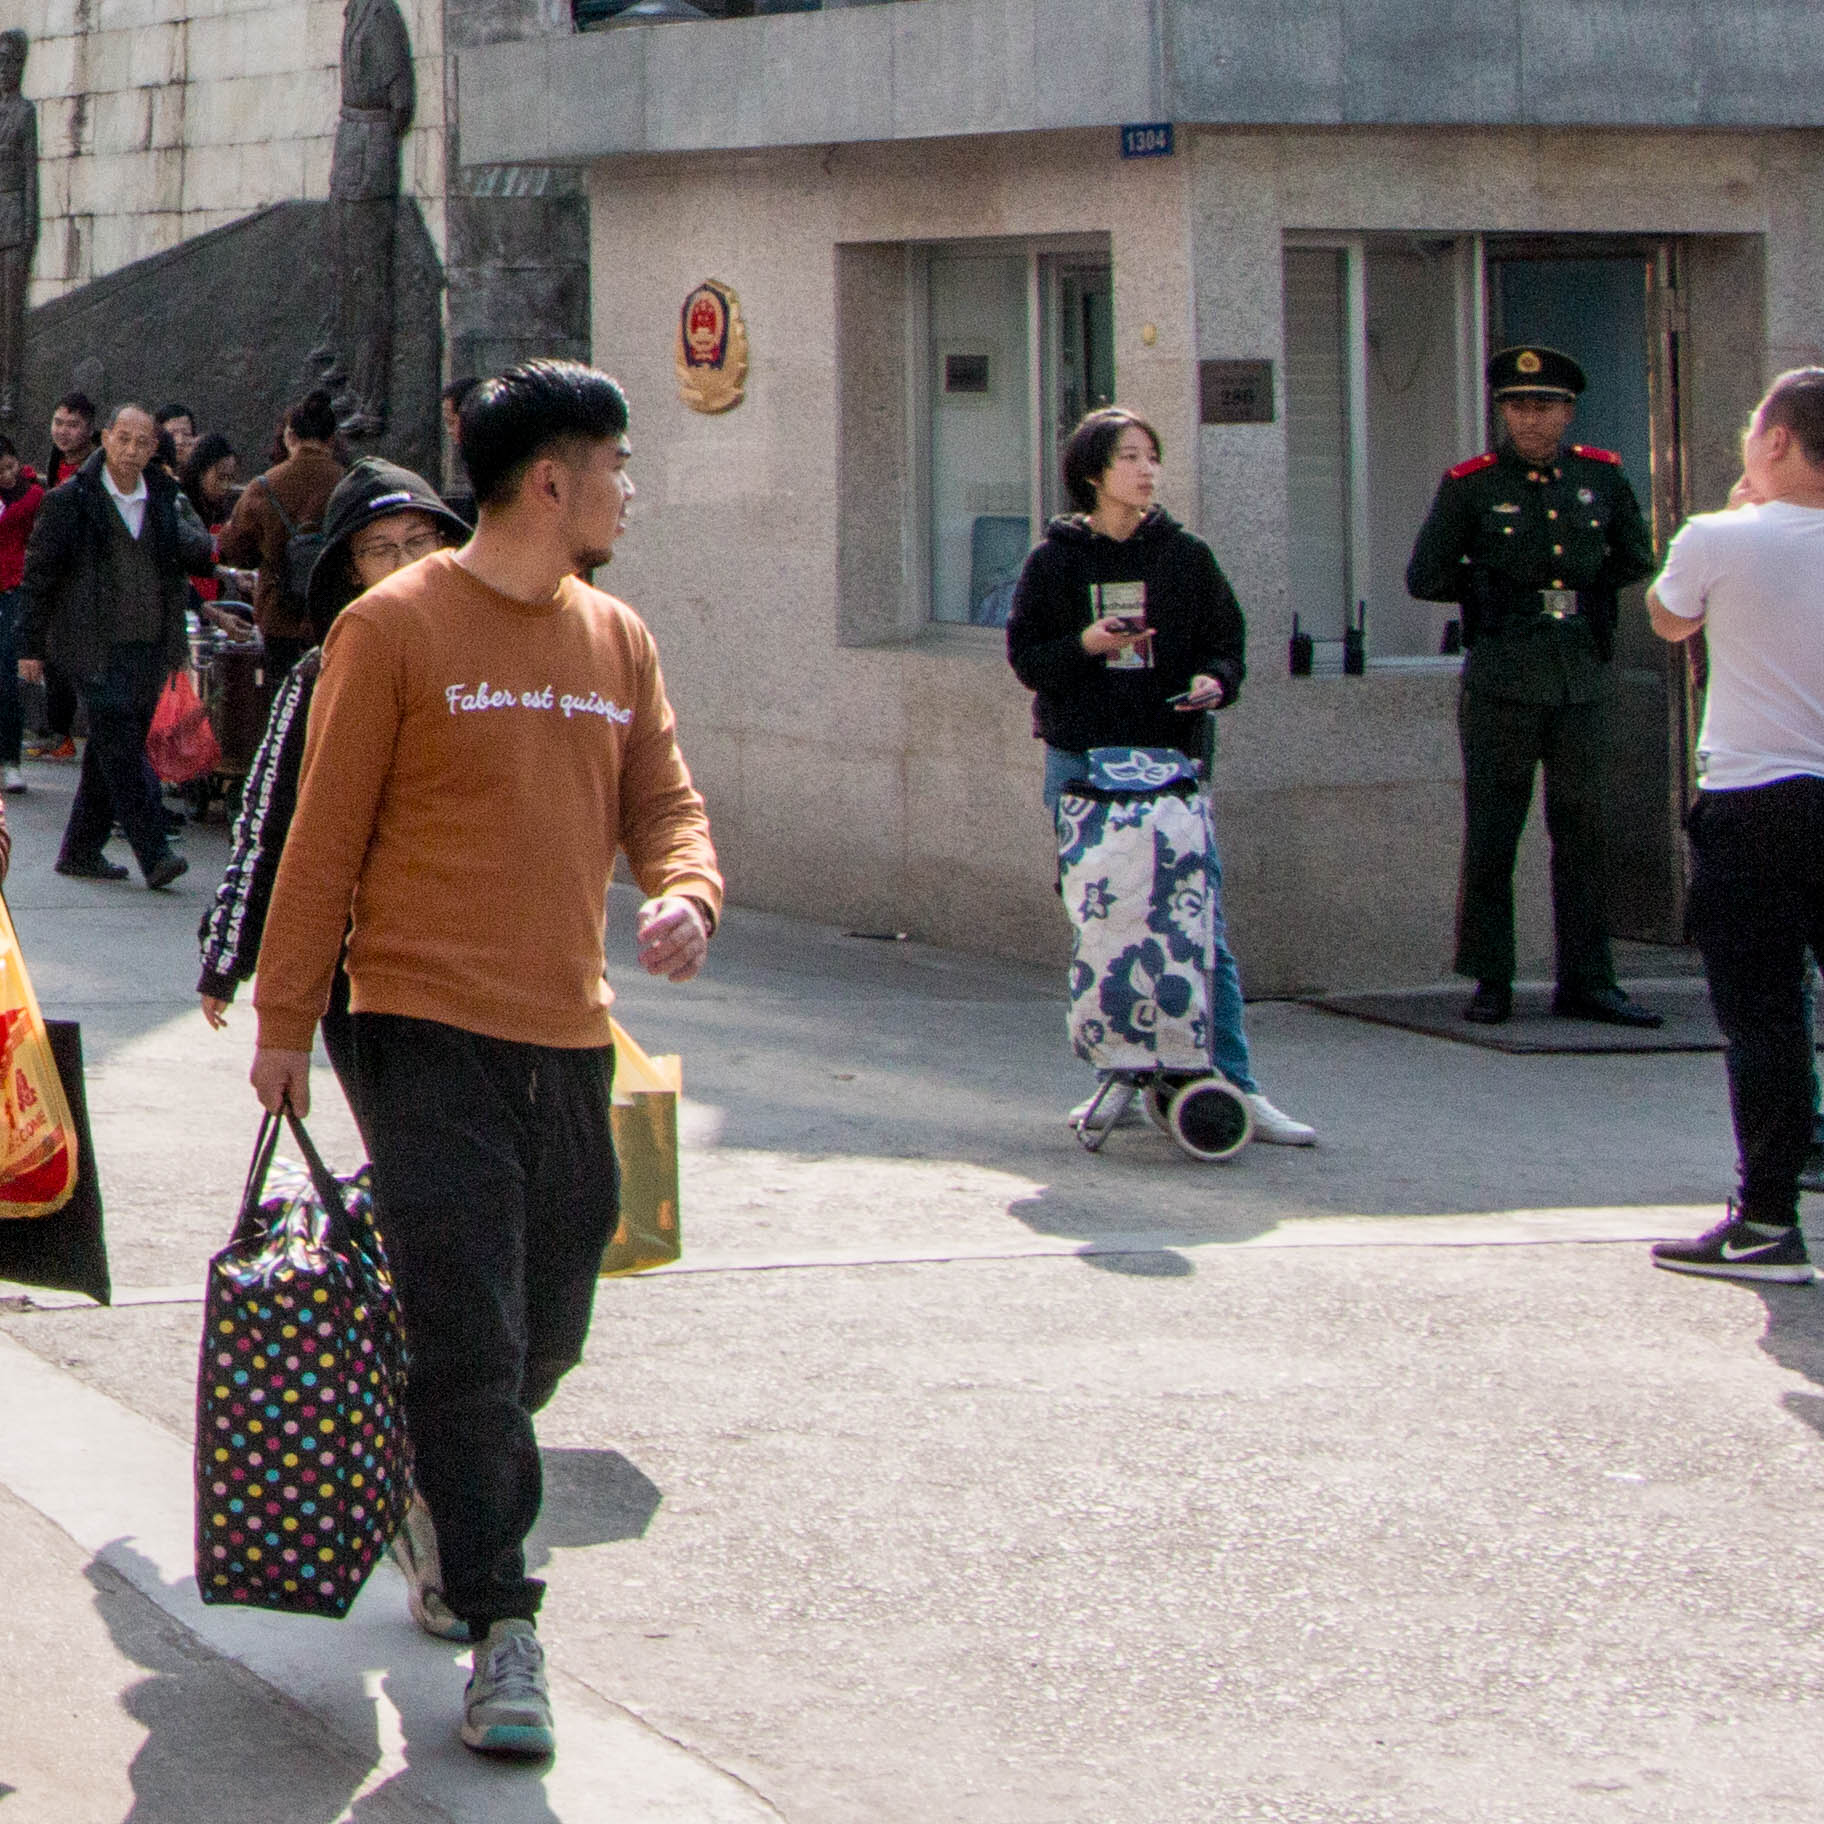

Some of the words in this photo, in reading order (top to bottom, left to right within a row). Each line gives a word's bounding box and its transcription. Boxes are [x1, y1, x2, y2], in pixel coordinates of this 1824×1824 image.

[1126, 128, 1167, 154] 1304
[445, 682, 517, 717] Faber
[520, 684, 554, 710] est
[558, 689, 633, 726] quisque
